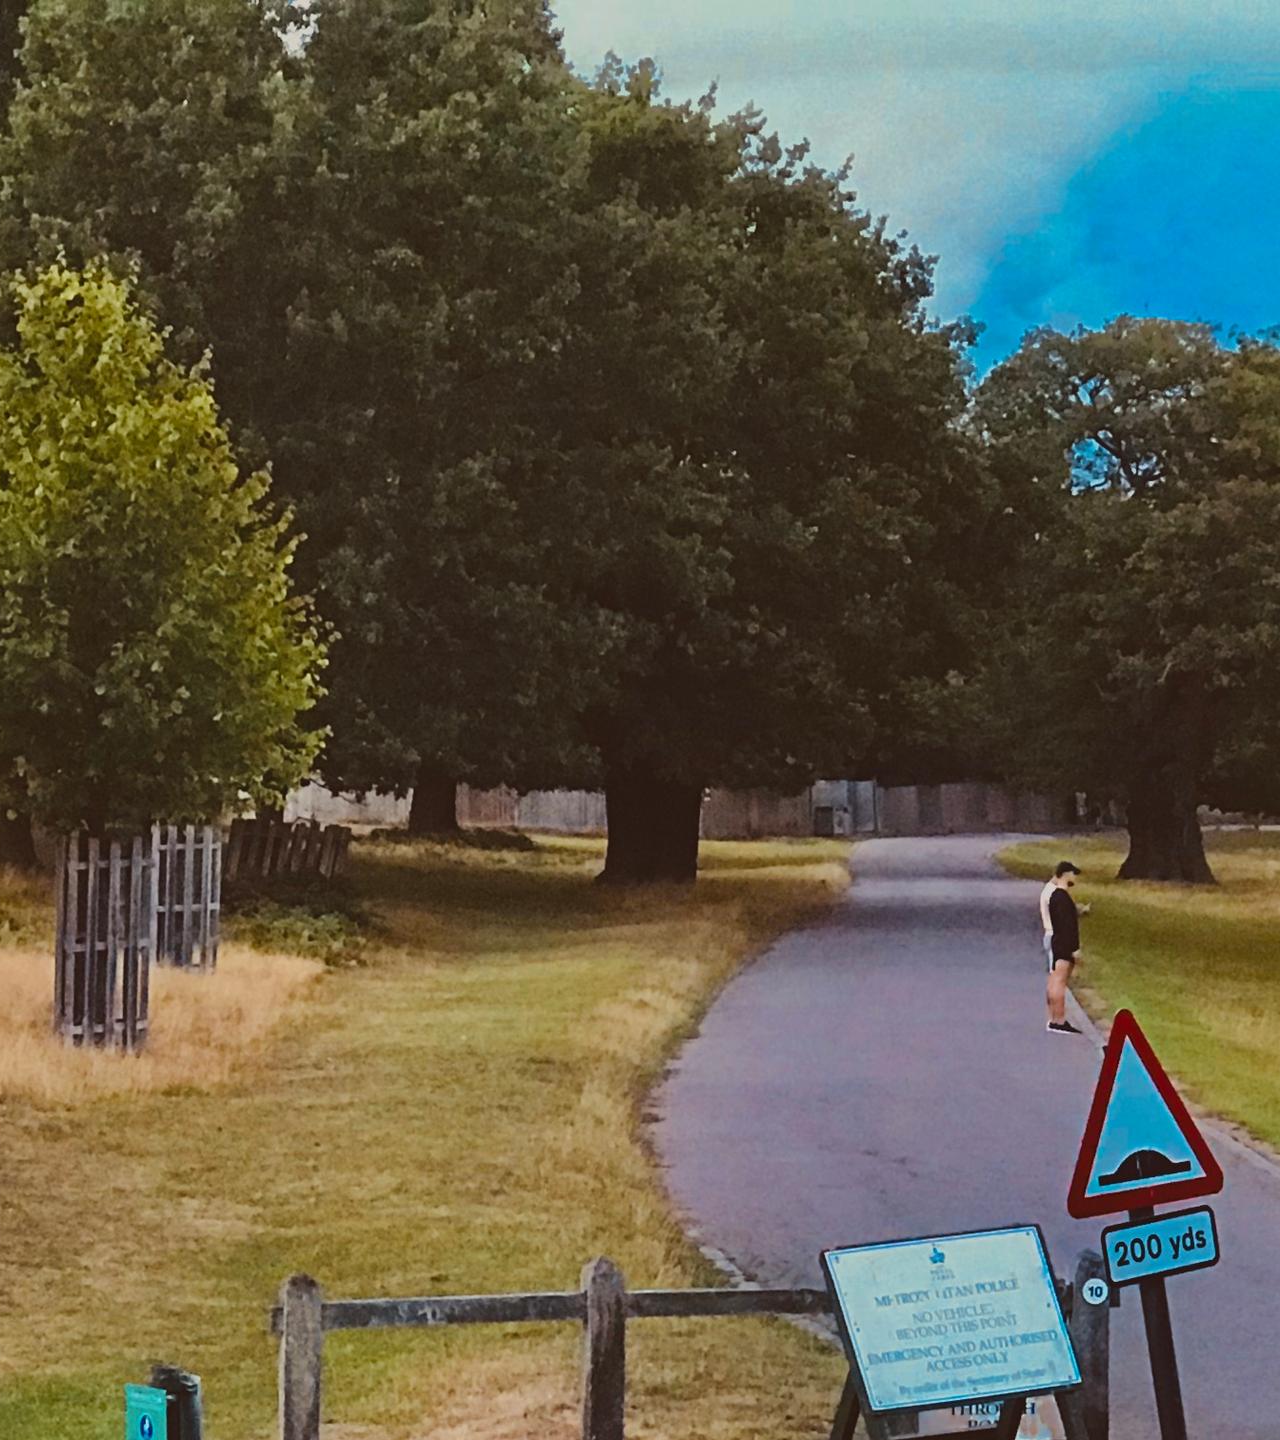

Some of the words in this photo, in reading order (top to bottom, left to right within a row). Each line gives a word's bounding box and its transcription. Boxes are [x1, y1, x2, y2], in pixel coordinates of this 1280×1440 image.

[1115, 1234, 1162, 1267] 200
[1169, 1226, 1207, 1260] yds
[875, 1284, 973, 1308] METROPLITAN
[976, 1278, 1019, 1295] POLICE
[1088, 1286, 1103, 1298] 10
[896, 1324, 948, 1341] BEYOND
[949, 1320, 978, 1334] THIS
[979, 1314, 1017, 1331] POINT
[912, 1311, 933, 1324] NO
[867, 1344, 946, 1364] EMERGENCY
[948, 1340, 976, 1356] AND
[979, 1329, 1058, 1350] AUTHORISED
[927, 1357, 973, 1373] ACCESS
[973, 1351, 1009, 1366] ONLY
[950, 1402, 1036, 1415] THROH
